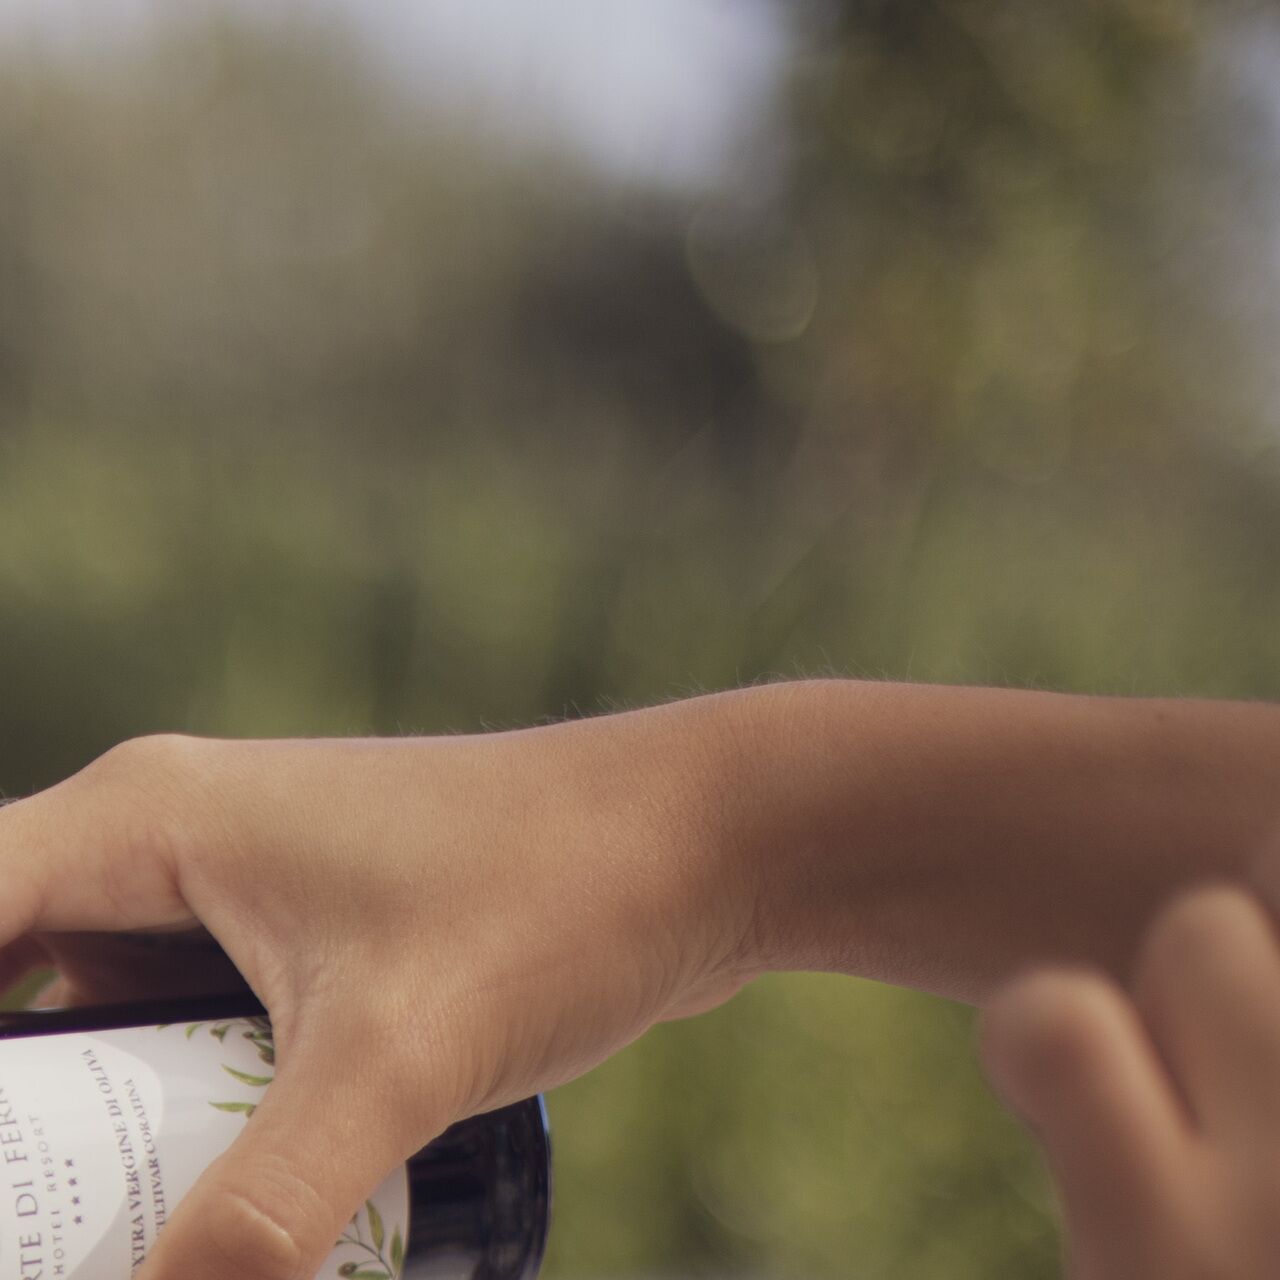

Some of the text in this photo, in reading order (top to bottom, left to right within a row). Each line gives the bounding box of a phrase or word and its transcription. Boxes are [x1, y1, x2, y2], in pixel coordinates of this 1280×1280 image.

[81, 1048, 113, 1095] OLIVA
[105, 1098, 123, 1118] DI
[122, 1078, 157, 1155] CORATINA
[28, 1114, 57, 1192] RESORT
[114, 1120, 143, 1212] VERGINE
[12, 1180, 39, 1218] DI
